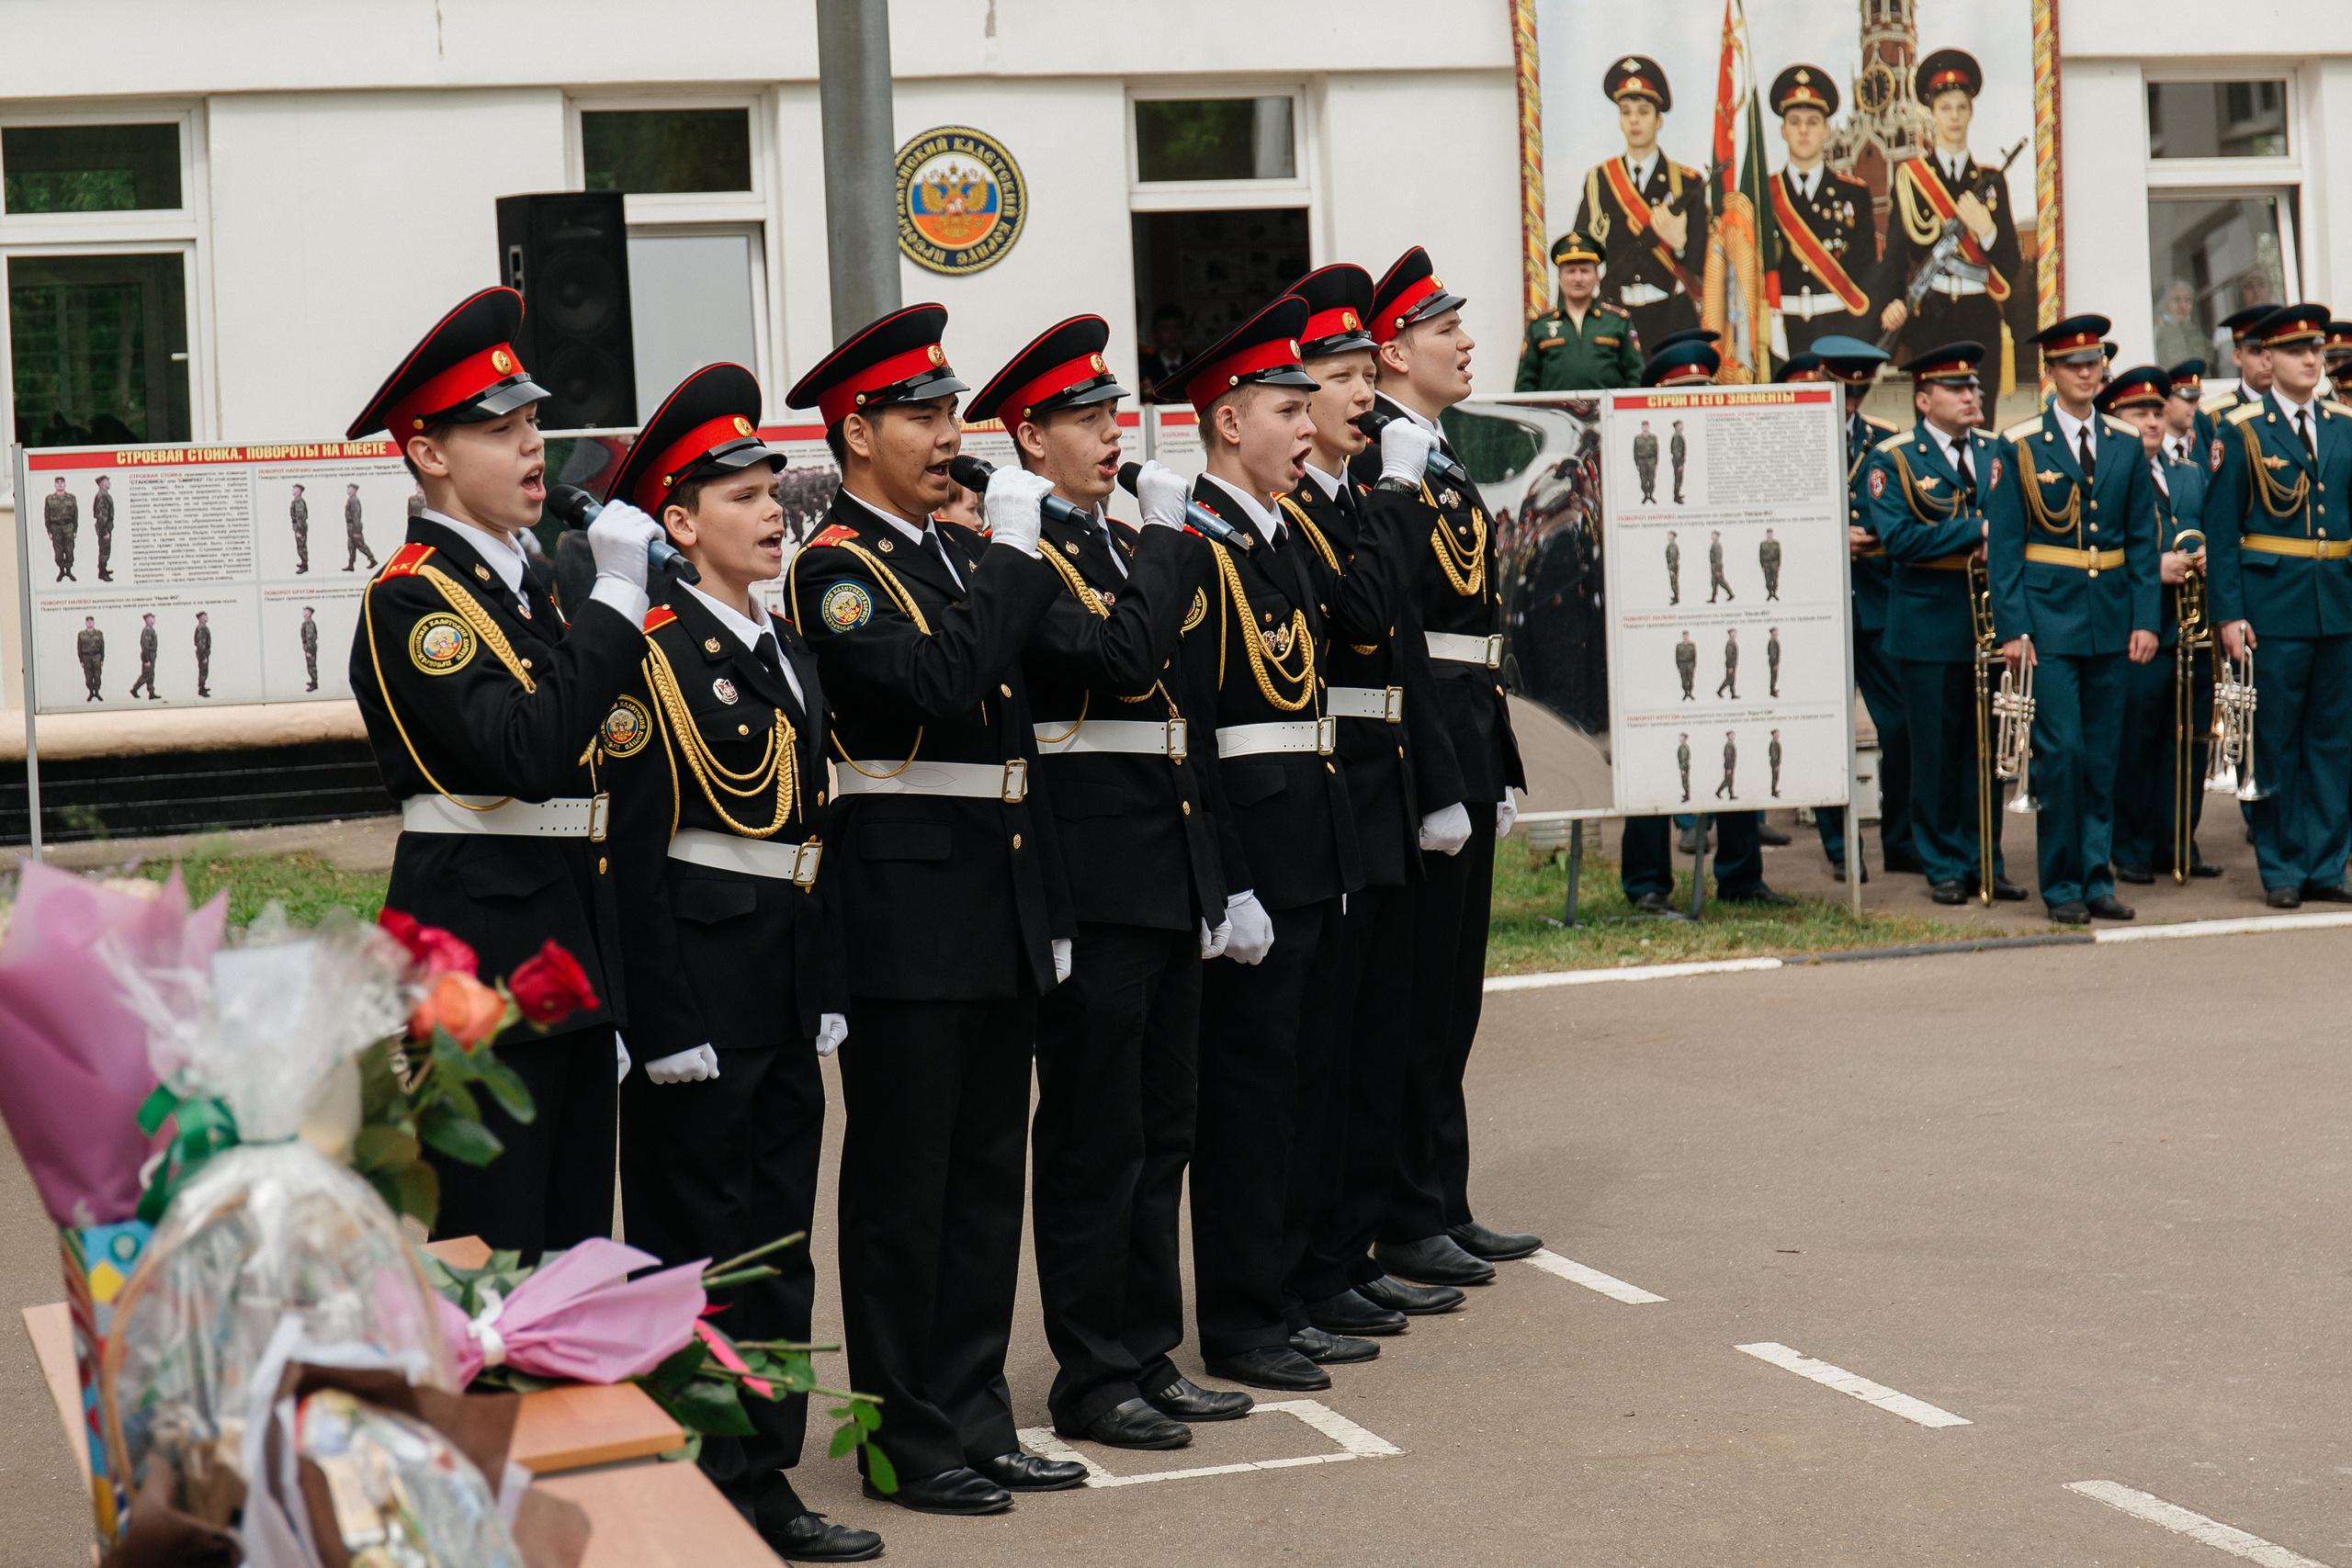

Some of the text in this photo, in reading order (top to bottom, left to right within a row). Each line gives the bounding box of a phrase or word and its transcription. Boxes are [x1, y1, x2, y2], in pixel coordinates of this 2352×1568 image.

[954, 138, 1018, 218] КАДЕТСКИЙ
[956, 222, 1012, 265] КОРПУС
[1690, 394, 1700, 406] И
[1702, 393, 1724, 406] ЕГО
[1727, 391, 1795, 405] ЭЛЕМЕНТЫ
[117, 450, 184, 465] СТРОЕВАЯ
[246, 445, 319, 459] ПОВОРОТЫ
[322, 443, 340, 457] НА
[344, 442, 386, 456] МЕСТЕ
